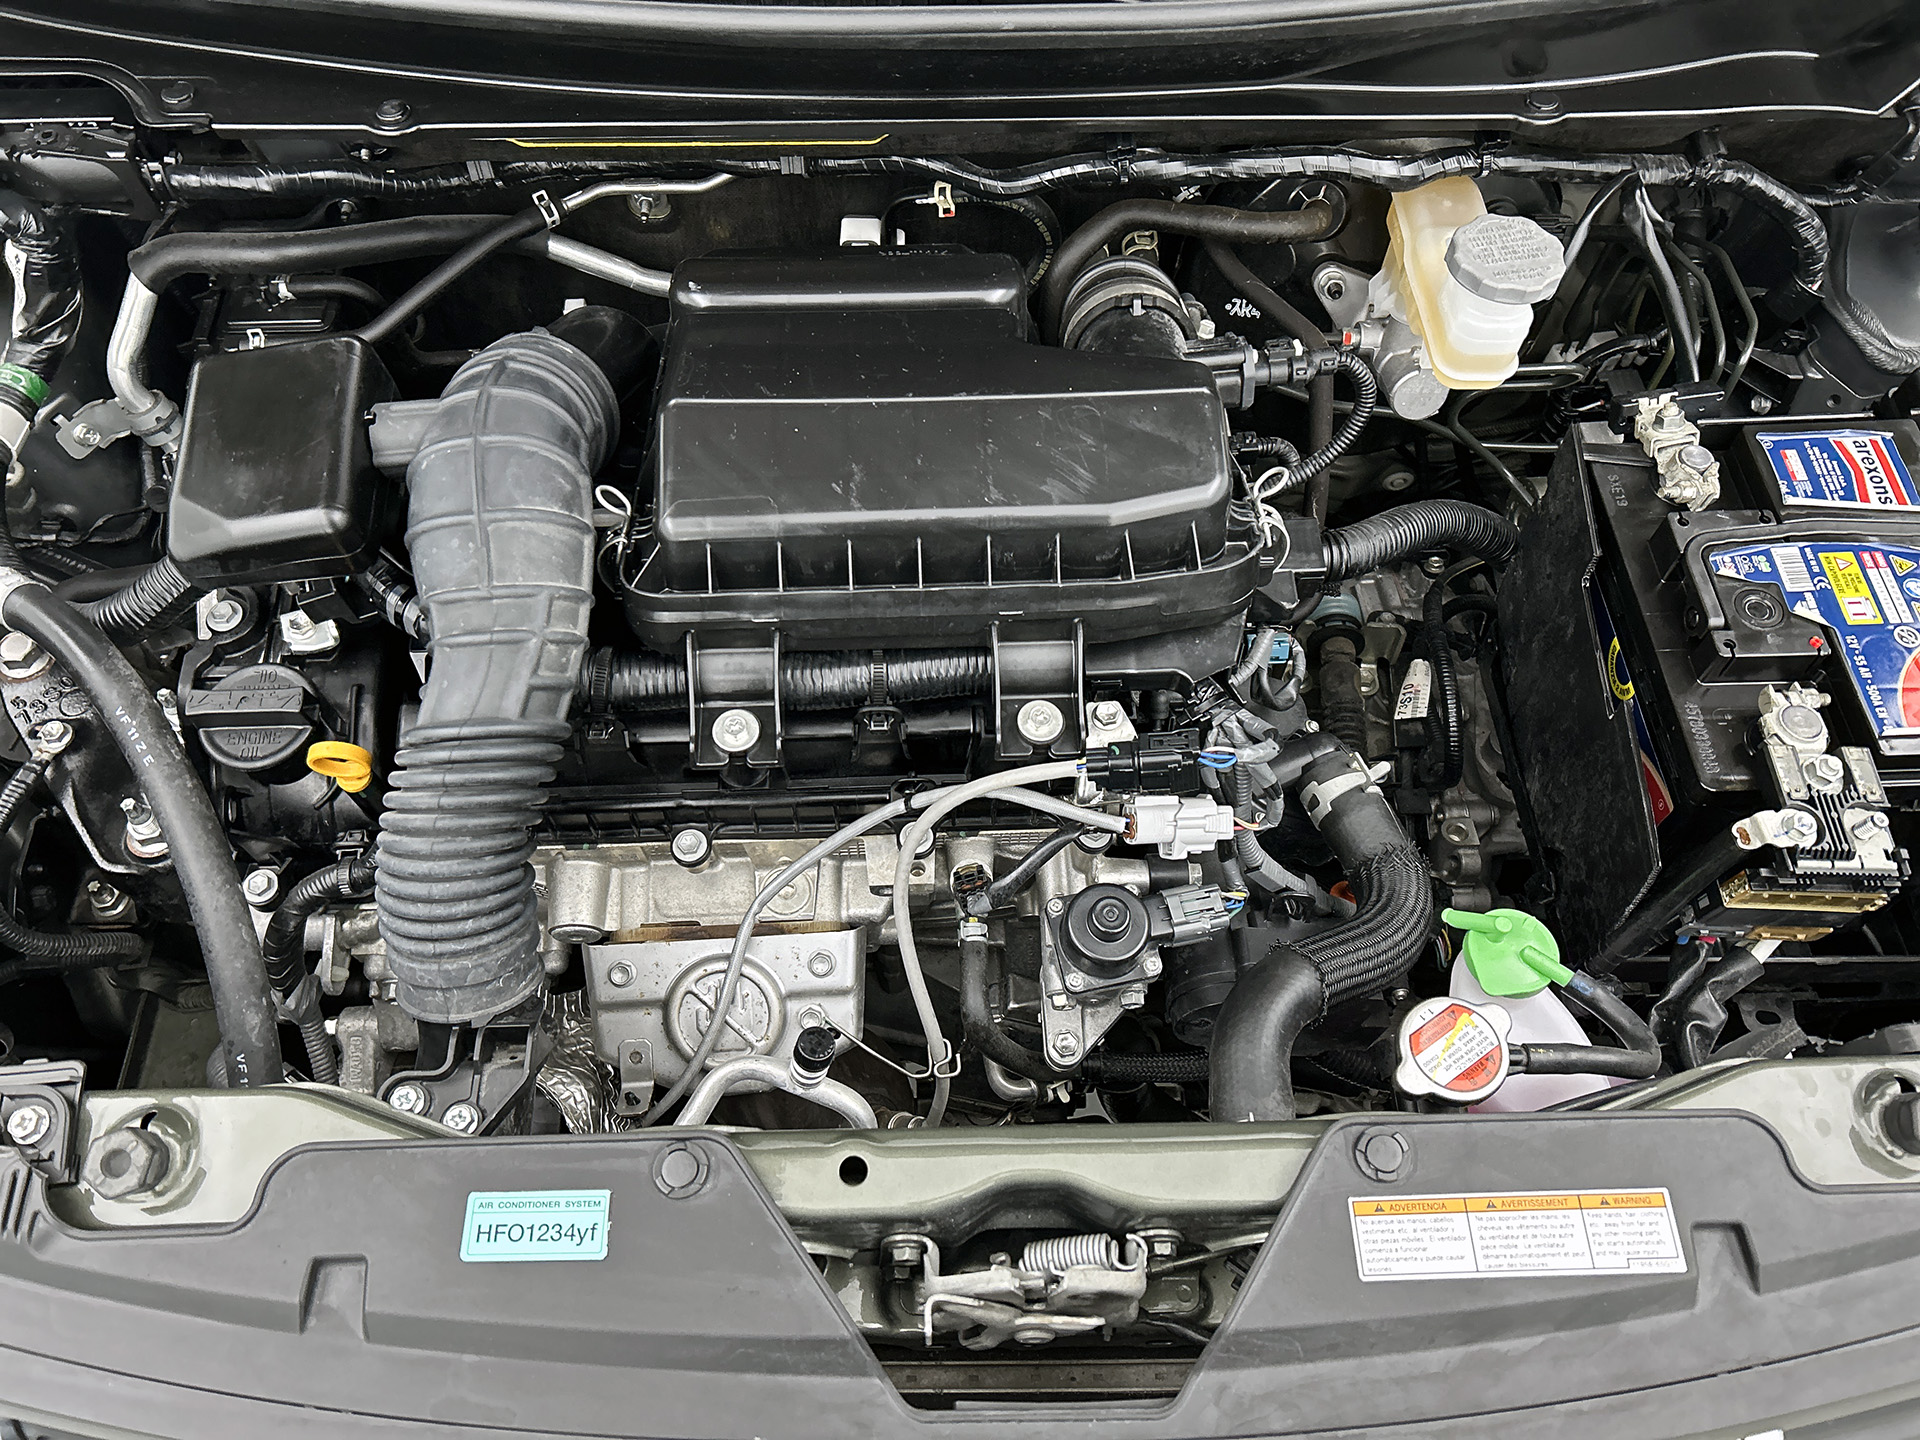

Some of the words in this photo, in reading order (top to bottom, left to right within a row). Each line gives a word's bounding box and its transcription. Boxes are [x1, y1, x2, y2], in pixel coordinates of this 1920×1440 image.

[1852, 440, 1893, 505] arexons
[1845, 635, 1860, 649] 12V
[1853, 655, 1867, 666] 55
[1858, 667, 1873, 678] AH
[1397, 683, 1414, 716] 73S10
[1866, 685, 1883, 706] 500A
[227, 731, 282, 746] ENGINE
[240, 746, 263, 760] OIL
[236, 1053, 248, 1073] VF
[498, 1201, 560, 1209] CONDITIONER
[565, 1200, 601, 1208] SYSTEM
[1389, 1202, 1447, 1212] ADVERTENCIA
[1501, 1198, 1568, 1208] AVERTISSEMENT
[1612, 1196, 1652, 1205] WARNING
[476, 1222, 599, 1247] HFO1234yf
